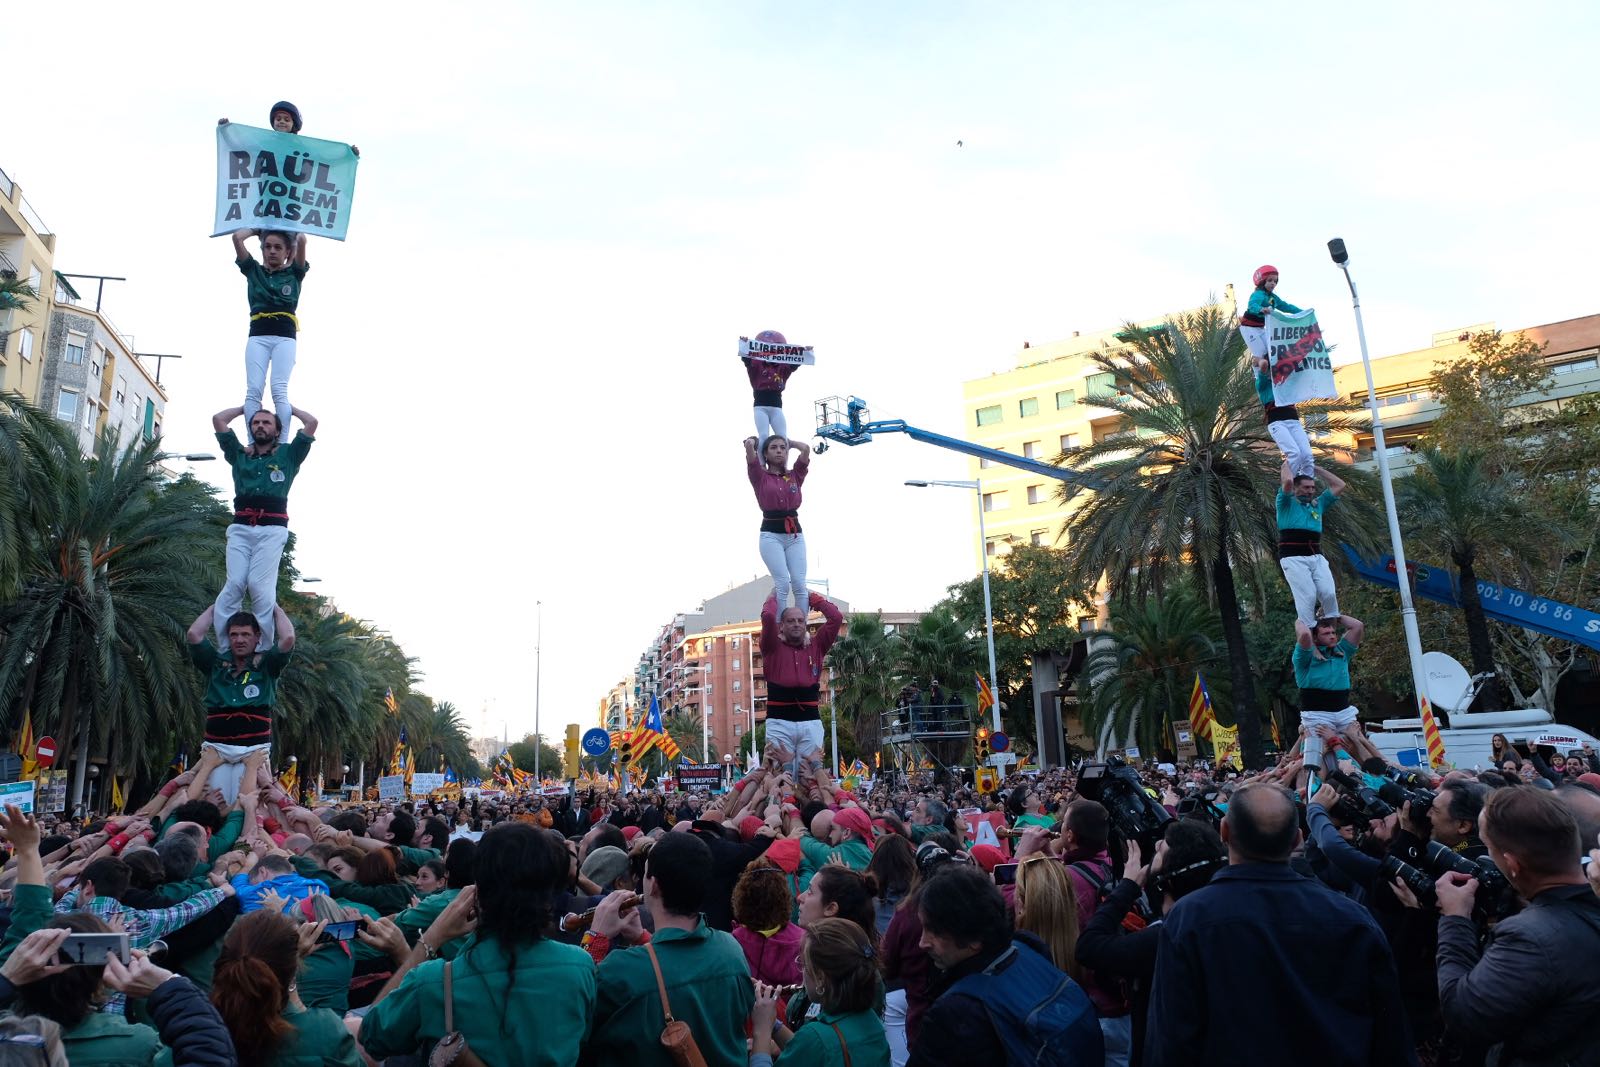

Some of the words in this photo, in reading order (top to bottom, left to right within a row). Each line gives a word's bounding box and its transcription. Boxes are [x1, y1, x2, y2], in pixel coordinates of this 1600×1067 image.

[229, 150, 340, 195] RAÜL,
[227, 182, 250, 200] ET
[257, 179, 338, 211] VOLEM
[224, 202, 242, 221] A
[252, 199, 337, 229] CASA!
[749, 341, 805, 356] LLIBERTAT
[1476, 584, 1503, 601] 902
[1508, 593, 1524, 608] 10
[1529, 599, 1548, 615] 86
[1553, 606, 1573, 622] 86
[1584, 619, 1600, 633] S
[1539, 735, 1578, 743] LLIBERTAT
